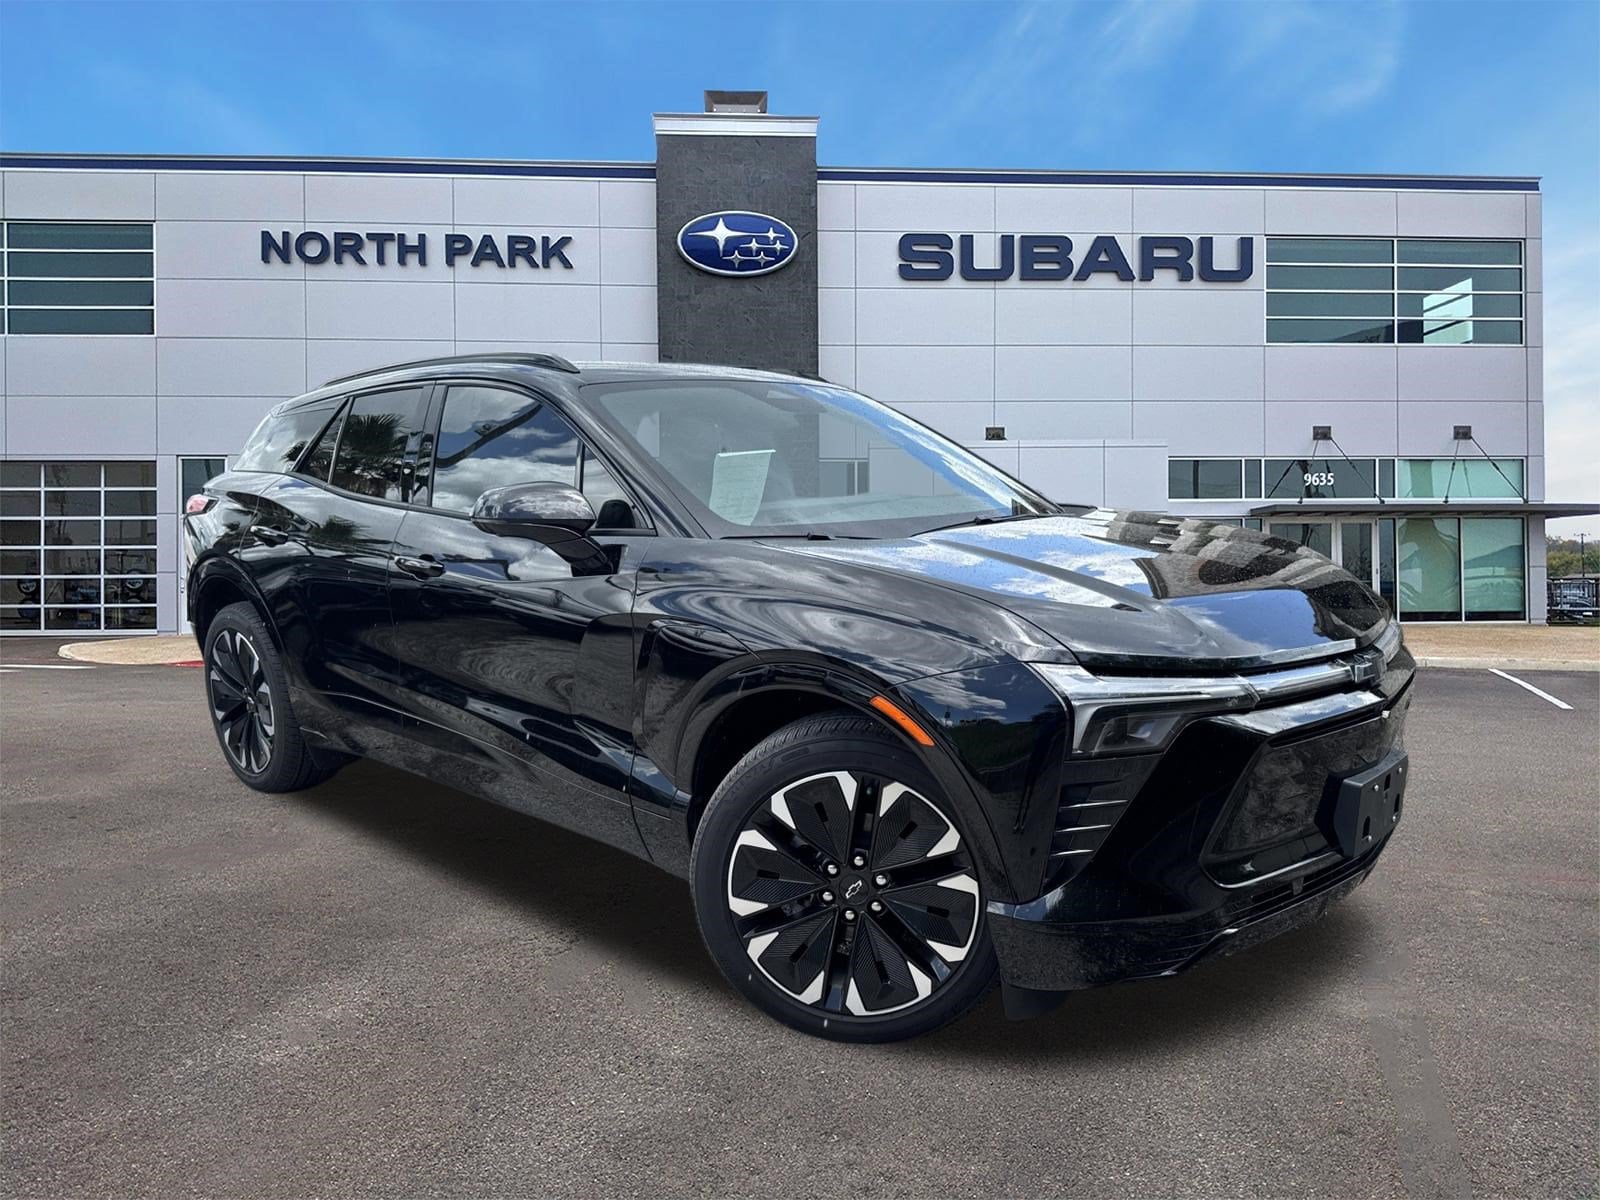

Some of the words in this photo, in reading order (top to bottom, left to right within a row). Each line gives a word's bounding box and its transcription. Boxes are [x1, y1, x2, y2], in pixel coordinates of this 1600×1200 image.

[261, 230, 427, 267] NORTH
[445, 234, 574, 270] PARK
[898, 233, 1254, 283] SUBARU
[1303, 472, 1335, 487] 9635
